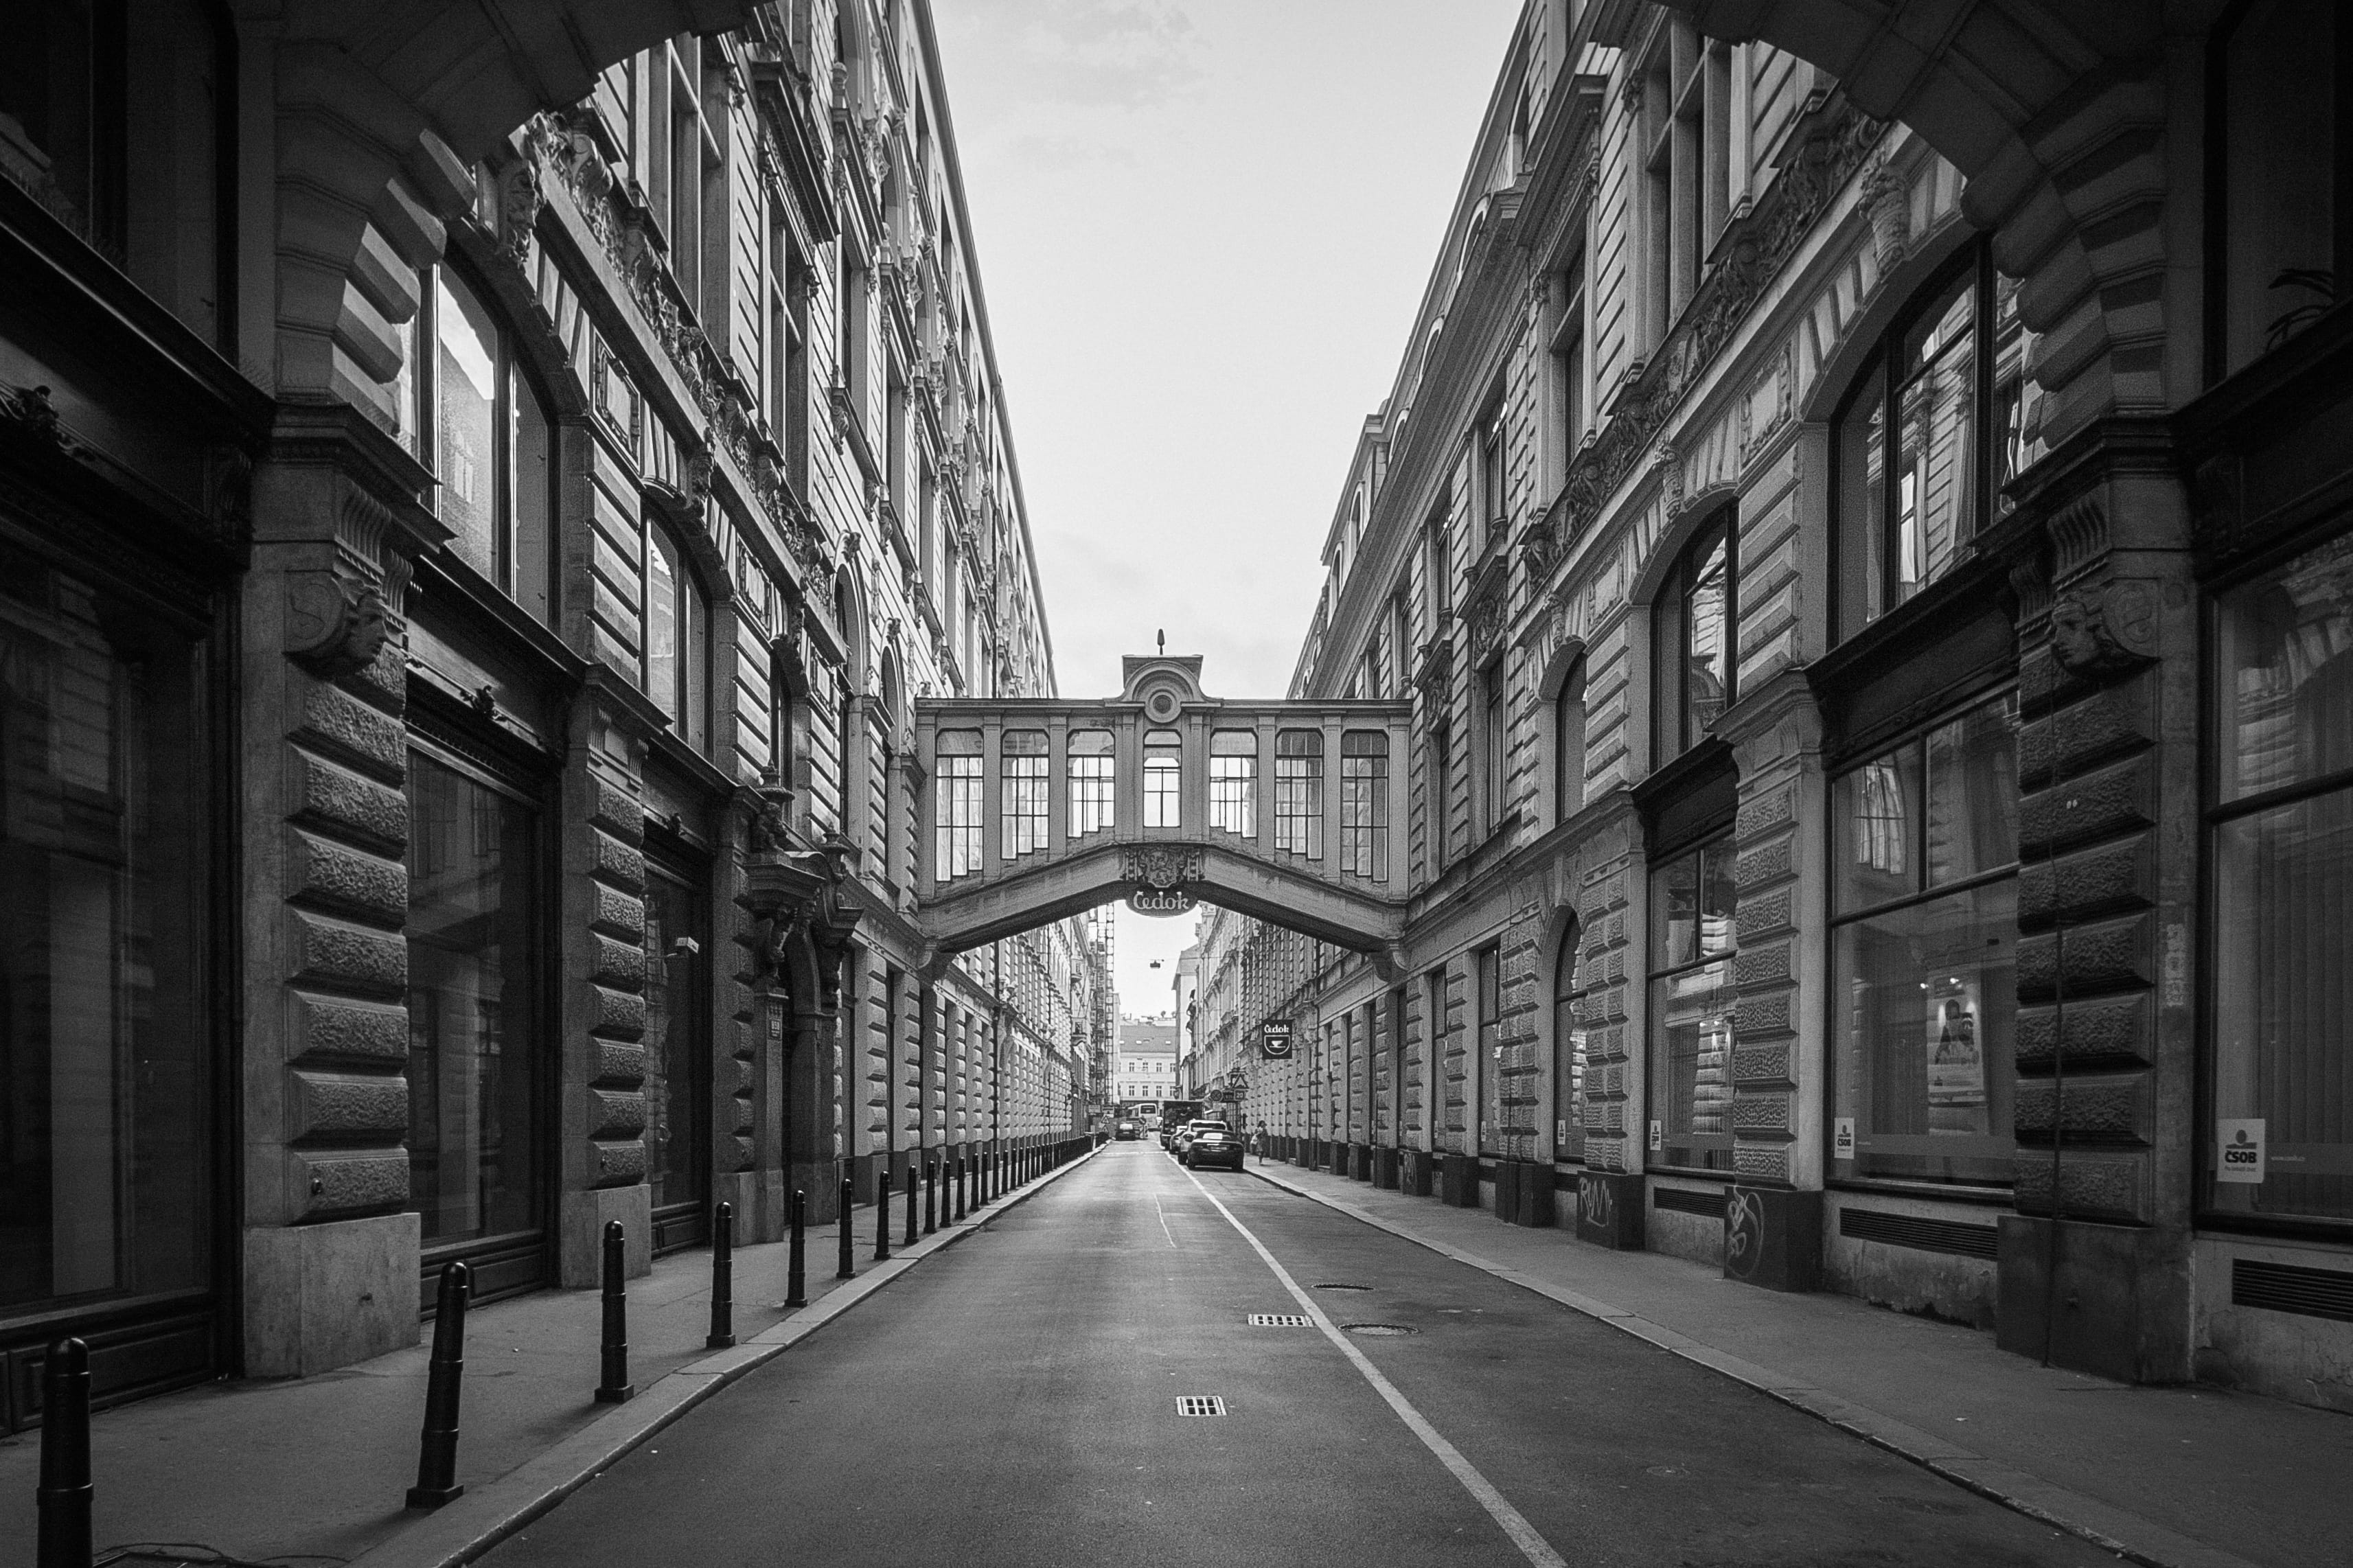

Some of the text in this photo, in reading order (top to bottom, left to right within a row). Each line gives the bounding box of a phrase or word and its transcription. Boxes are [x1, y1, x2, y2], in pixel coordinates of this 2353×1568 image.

[1134, 891, 1189, 910] Čedok
[1264, 1024, 1289, 1033] Čedok
[2225, 1150, 2257, 1163] ČSOB
